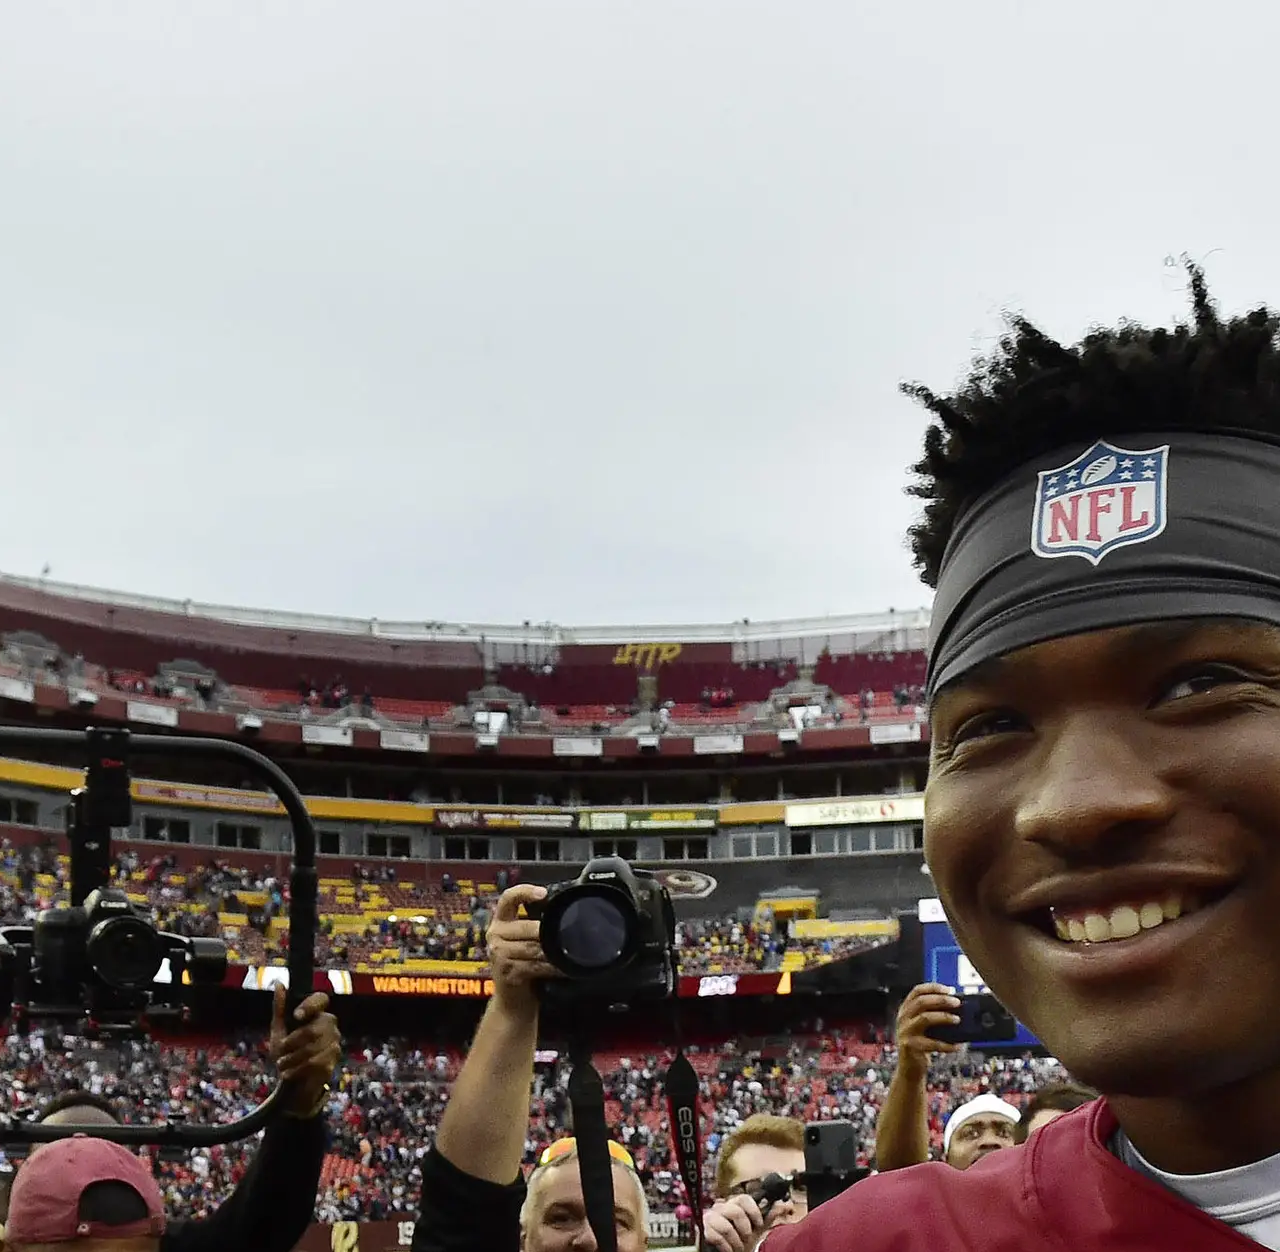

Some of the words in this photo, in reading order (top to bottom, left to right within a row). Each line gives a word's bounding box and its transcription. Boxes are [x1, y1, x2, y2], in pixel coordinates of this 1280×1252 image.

[1046, 486, 1149, 543] NFL
[372, 975, 482, 995] WASHINGTON
[677, 1106, 695, 1153] EOS
